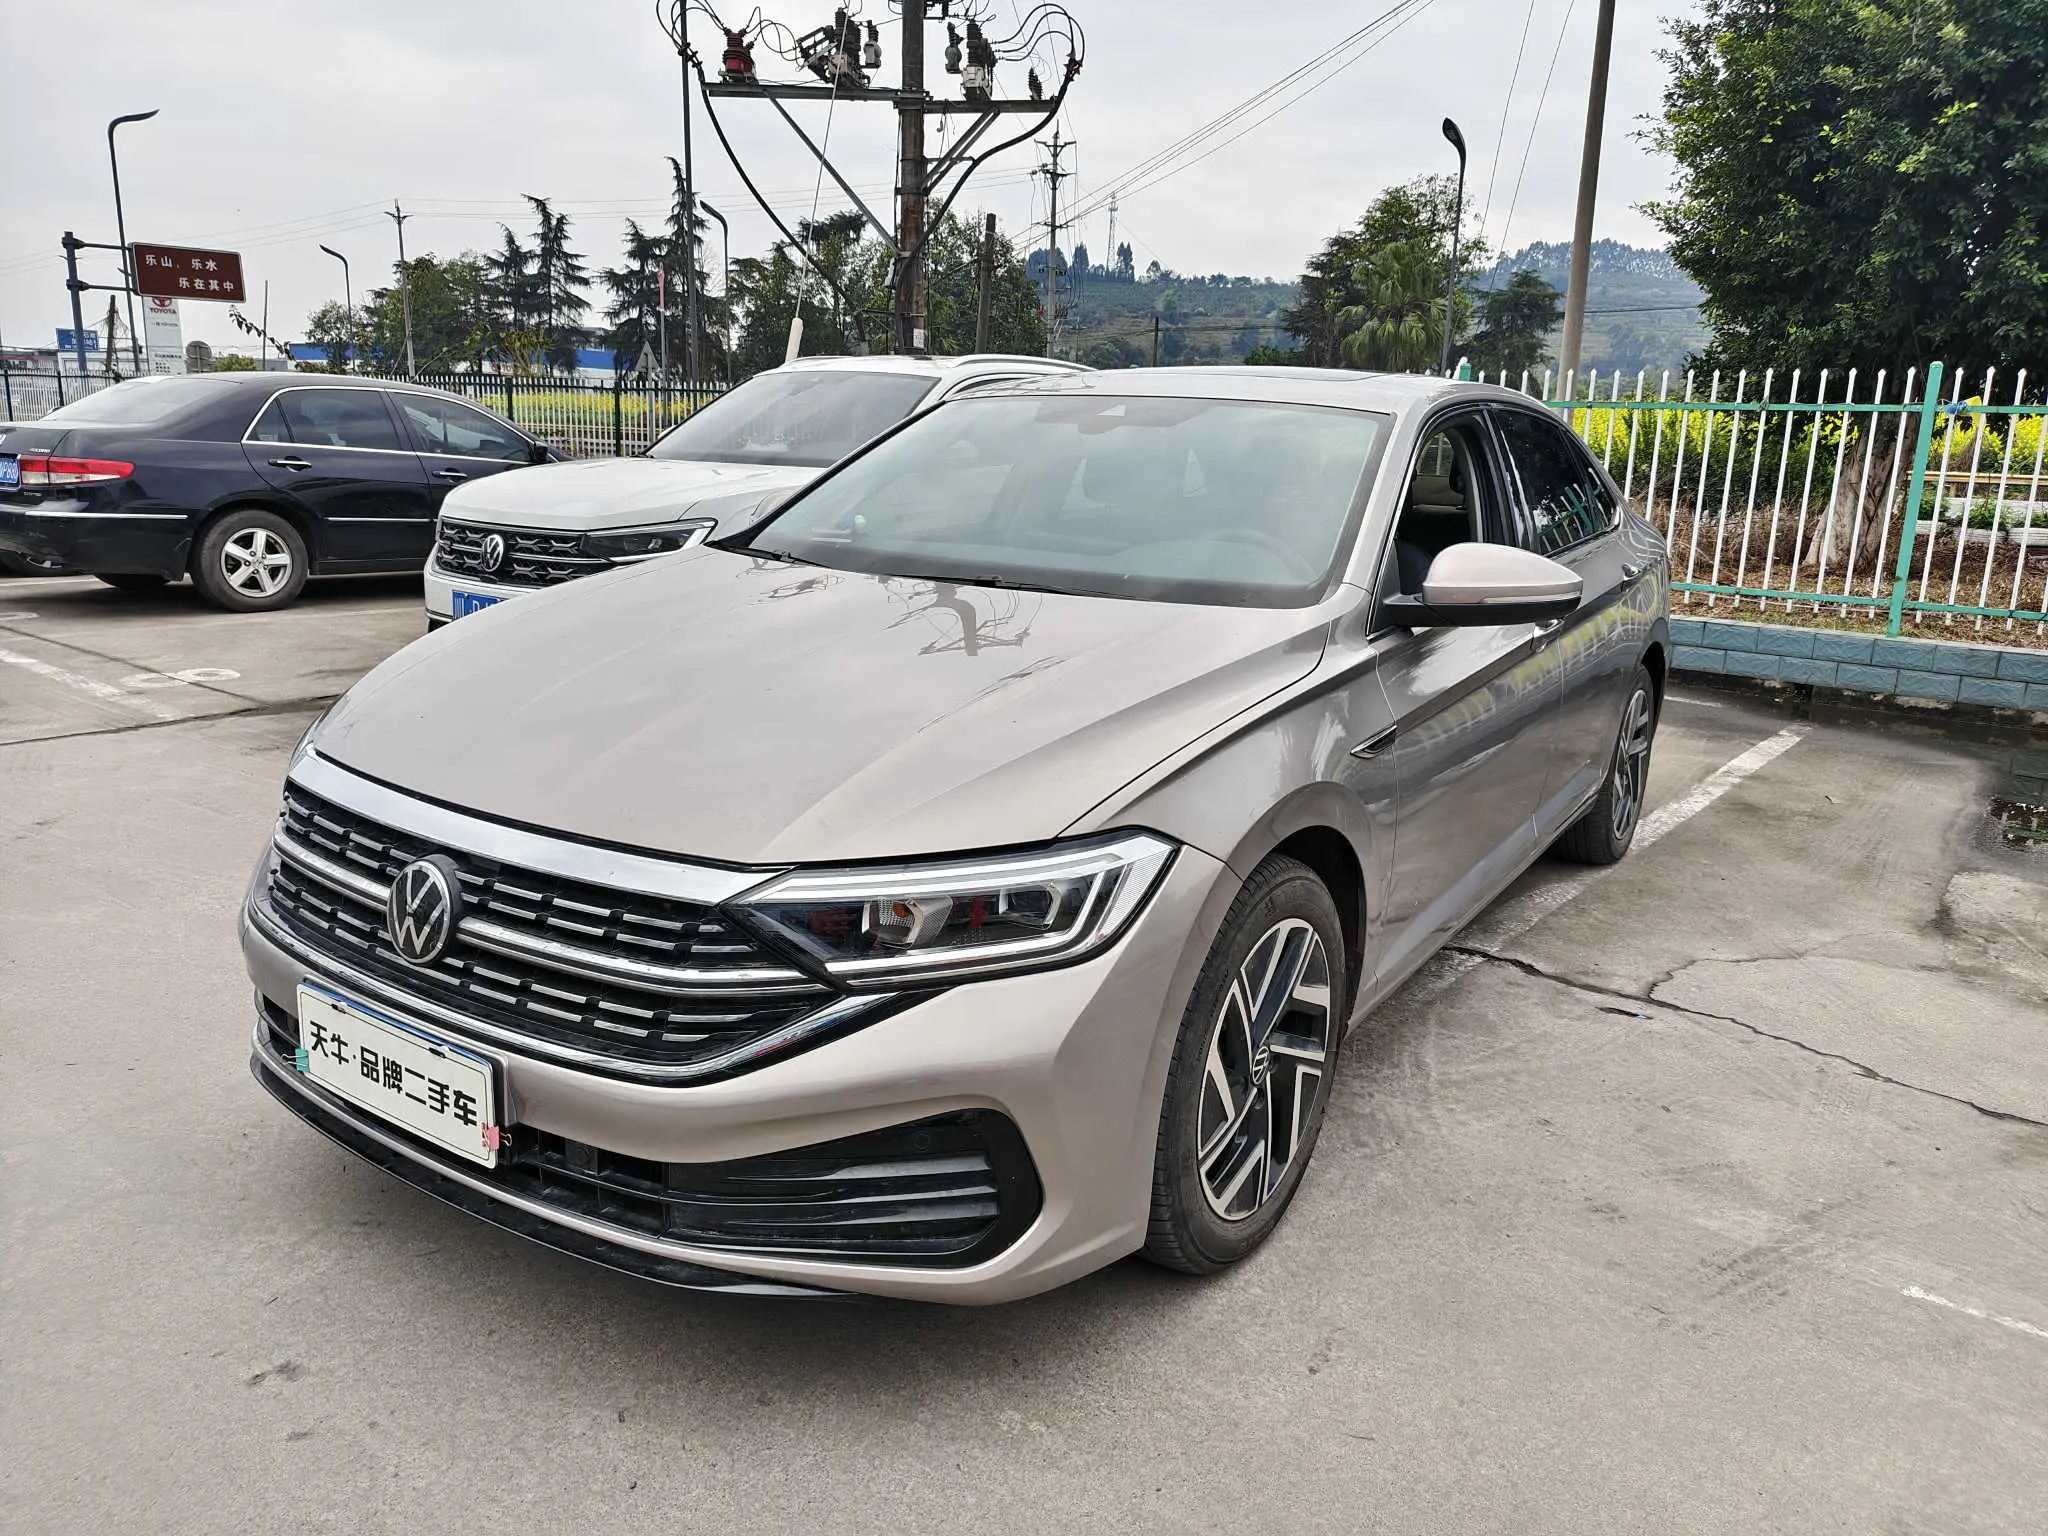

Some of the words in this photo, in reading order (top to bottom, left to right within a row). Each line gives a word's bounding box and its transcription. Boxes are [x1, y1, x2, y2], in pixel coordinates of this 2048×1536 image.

[191, 258, 218, 272] 乐水
[178, 277, 234, 292] 乐在其中
